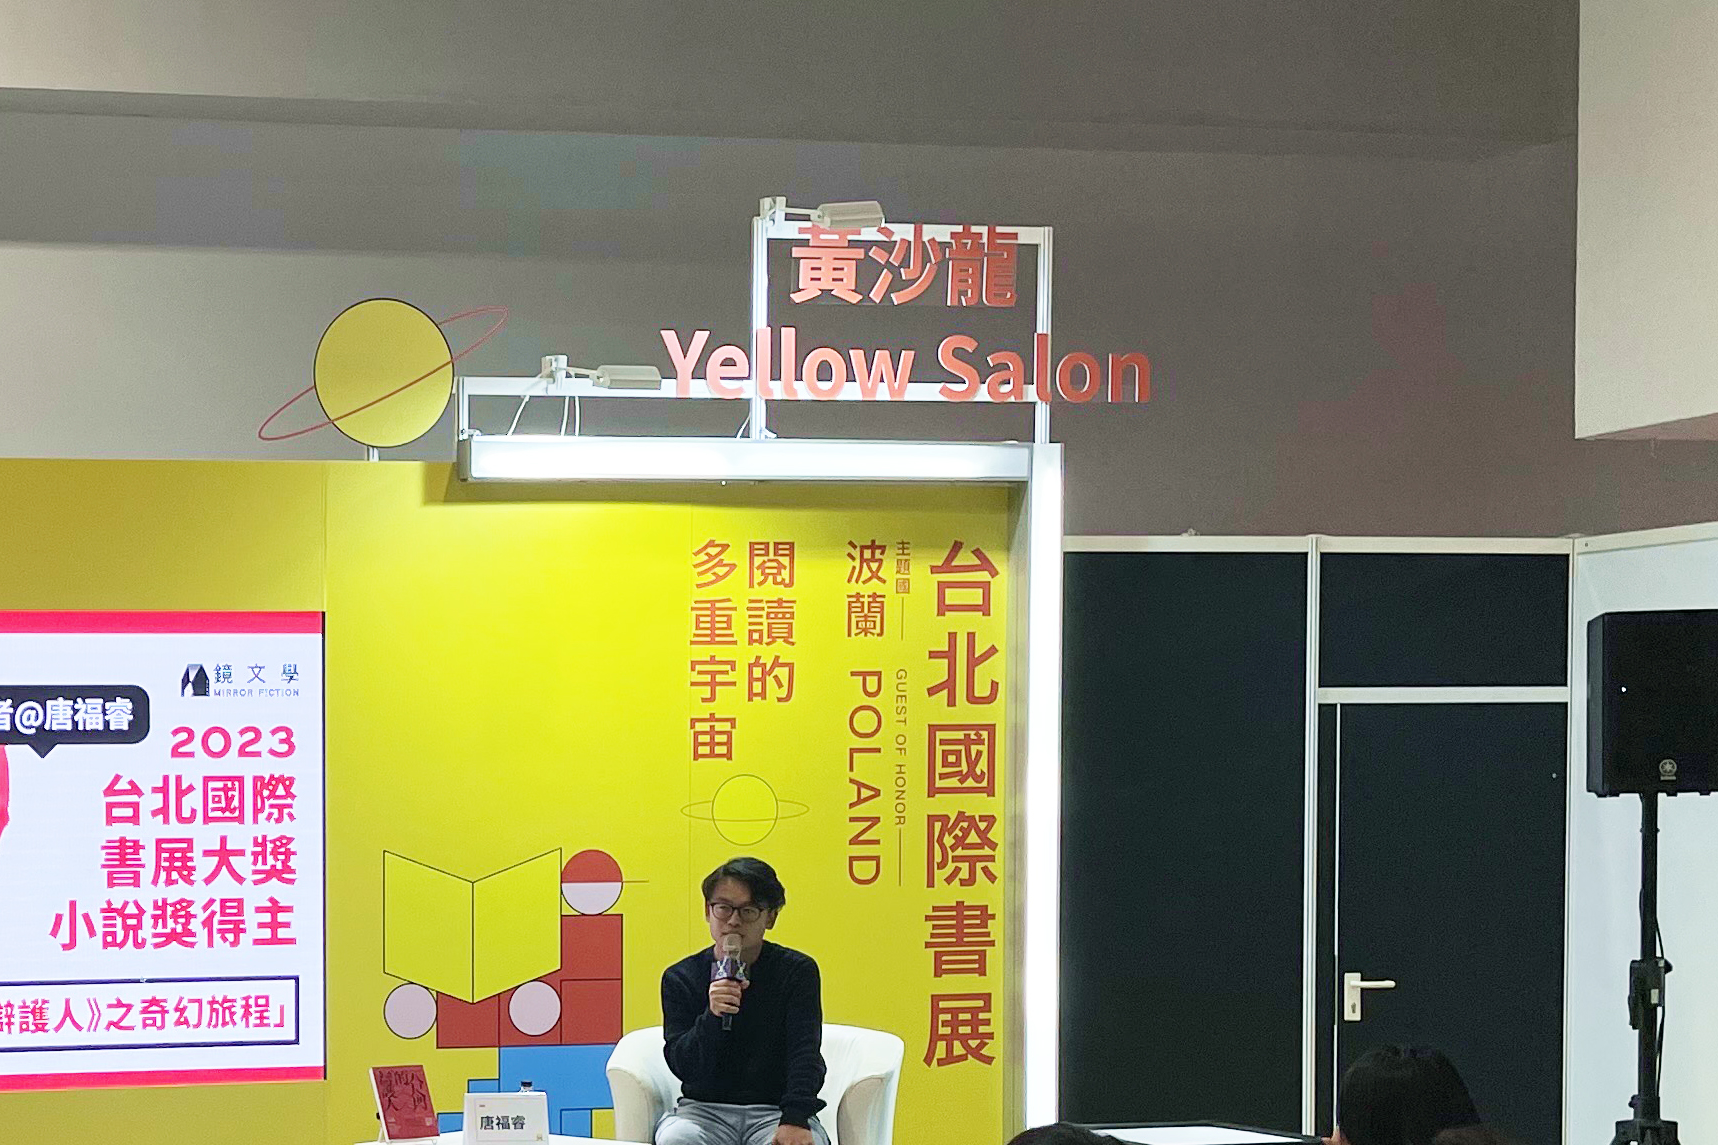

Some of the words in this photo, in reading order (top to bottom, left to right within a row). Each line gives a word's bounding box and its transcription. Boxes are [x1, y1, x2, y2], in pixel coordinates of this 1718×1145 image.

[790, 224, 1019, 307] 黃沙龍
[660, 326, 915, 401] Yellow
[938, 332, 1151, 403] Salon
[845, 540, 887, 639] 波蘭
[894, 540, 911, 595] 主題國
[746, 540, 797, 703] 閱讀的
[213, 663, 300, 684] 鏡文學
[689, 539, 738, 762] 多重宇宙
[213, 688, 254, 698] MIRROR
[258, 688, 300, 698] FICTION
[895, 668, 908, 726] GUEST
[170, 725, 297, 759] 2023
[895, 734, 908, 757] OF
[101, 773, 297, 827] 台北國際
[848, 669, 883, 886] POLAND
[894, 763, 907, 826] HONOR
[923, 540, 1000, 1068] 台北國際書展
[100, 834, 298, 888] 書展大獎
[48, 897, 298, 951] 小說獎得主
[480, 1115, 526, 1131] 唐福睿
